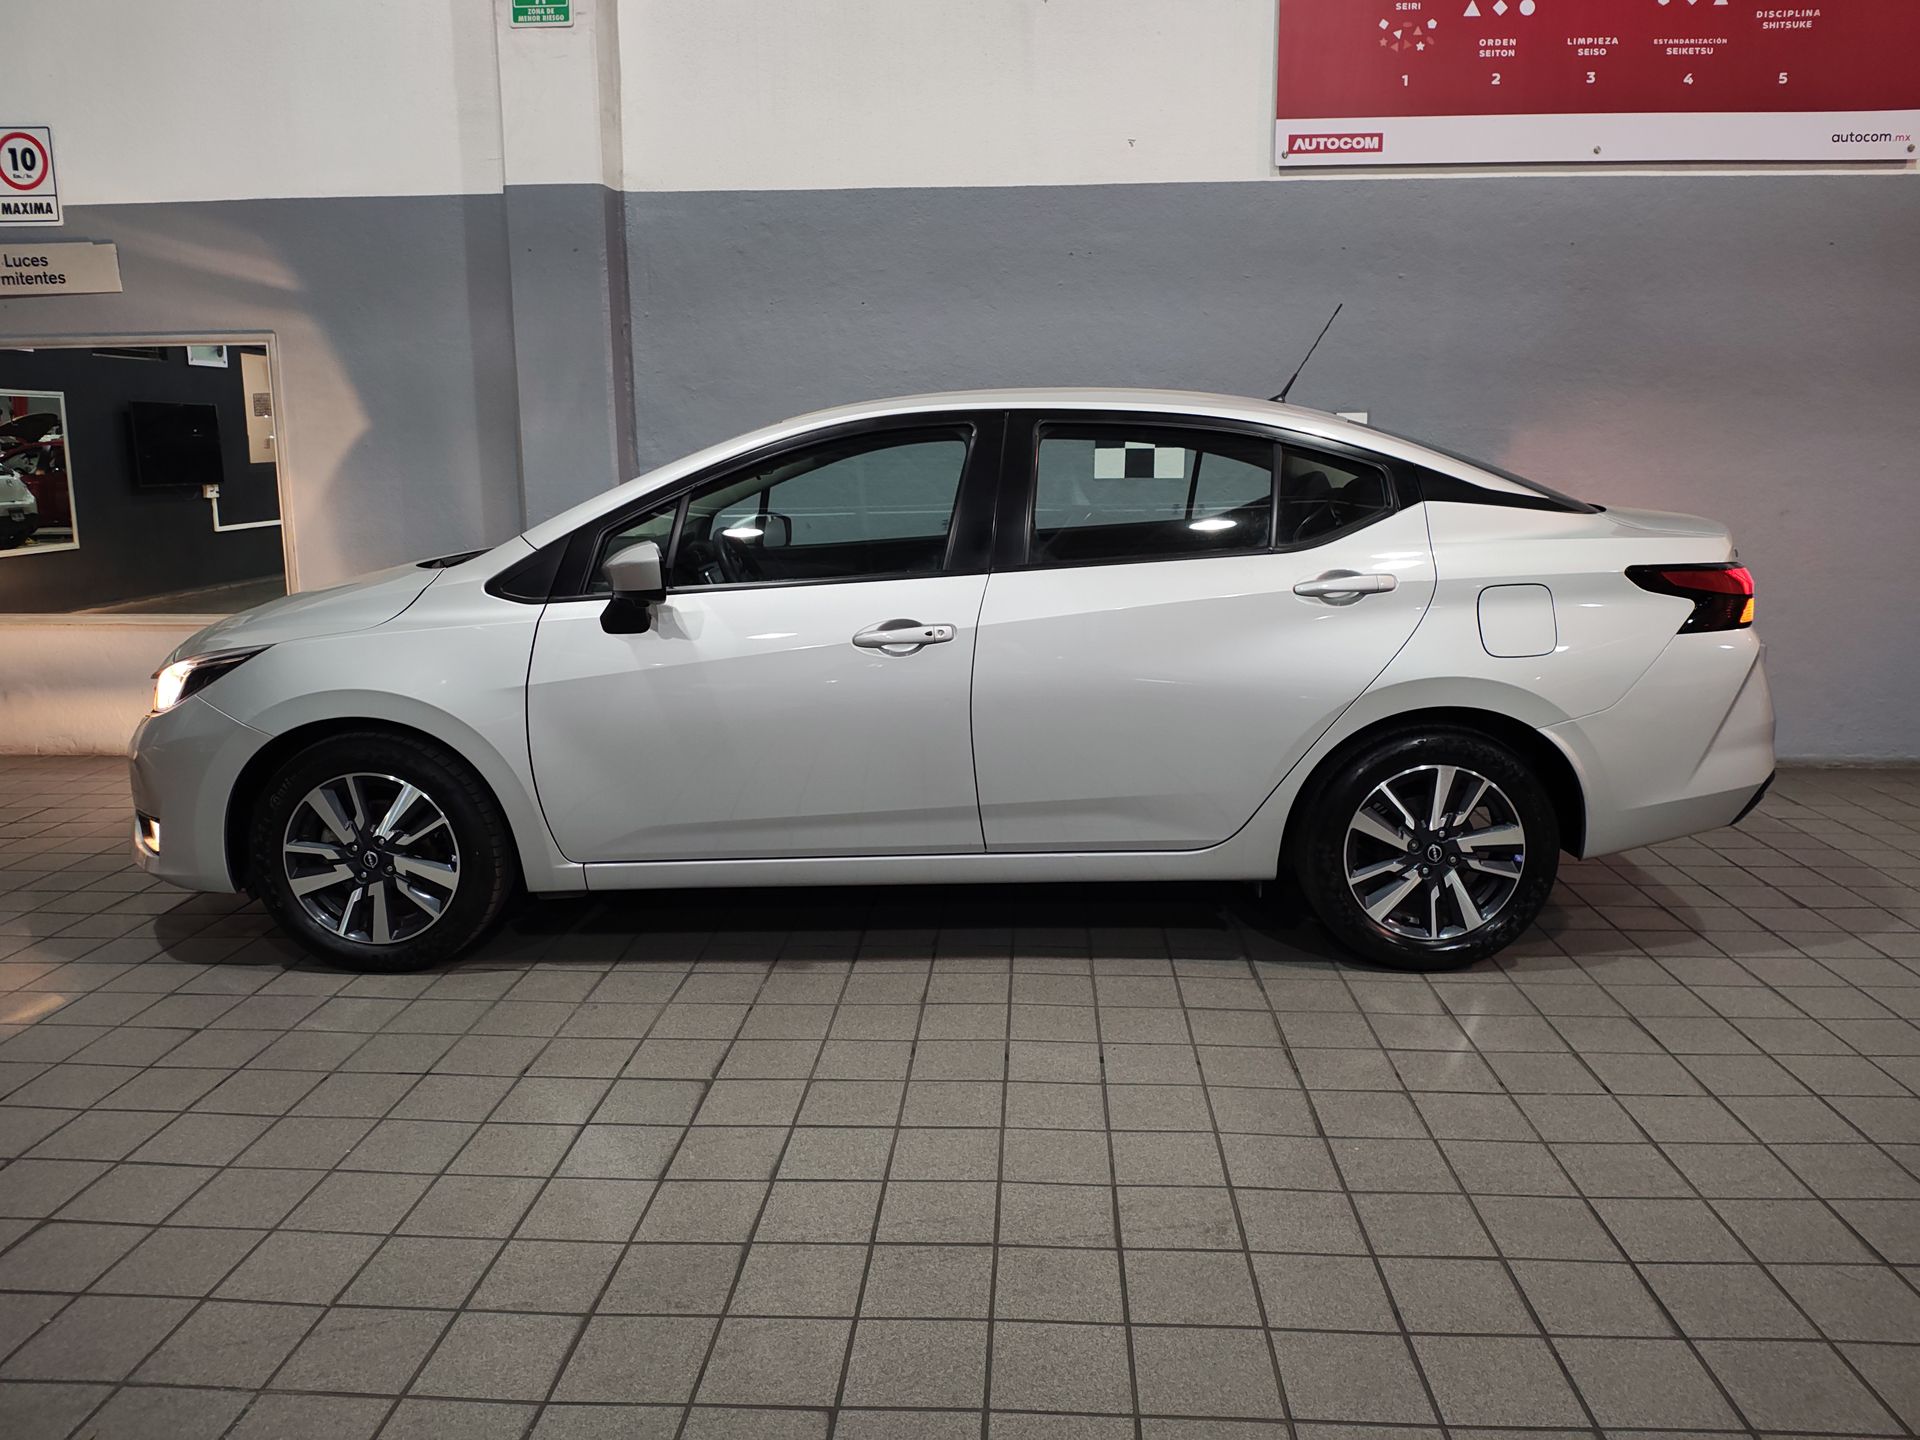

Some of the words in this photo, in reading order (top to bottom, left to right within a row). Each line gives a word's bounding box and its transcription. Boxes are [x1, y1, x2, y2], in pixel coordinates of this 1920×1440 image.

[1395, 2, 1421, 11] SEIRI
[542, 14, 565, 22] RIESGO
[1756, 9, 1821, 19] DISCIPLINA
[1762, 20, 1813, 30] SHITSUKE
[1479, 38, 1517, 47] ORDEN
[1567, 36, 1619, 46] LIMPIEZA
[1653, 37, 1728, 45] ESTANDARIZACIÓN
[1479, 49, 1516, 58] SEITON
[1577, 48, 1607, 56] SEISO
[1666, 47, 1714, 56] SEIKETSU
[1401, 74, 1409, 87] 1
[1491, 72, 1501, 86] 2
[1586, 71, 1596, 84] 3
[1683, 73, 1694, 85] 4
[1778, 72, 1788, 84] 5
[1831, 131, 1911, 143] autocom.mx
[1292, 136, 1380, 151] AUTOCOM
[7, 147, 36, 172] 10
[1, 202, 54, 215] MAXIMA
[3, 253, 49, 268] Luces
